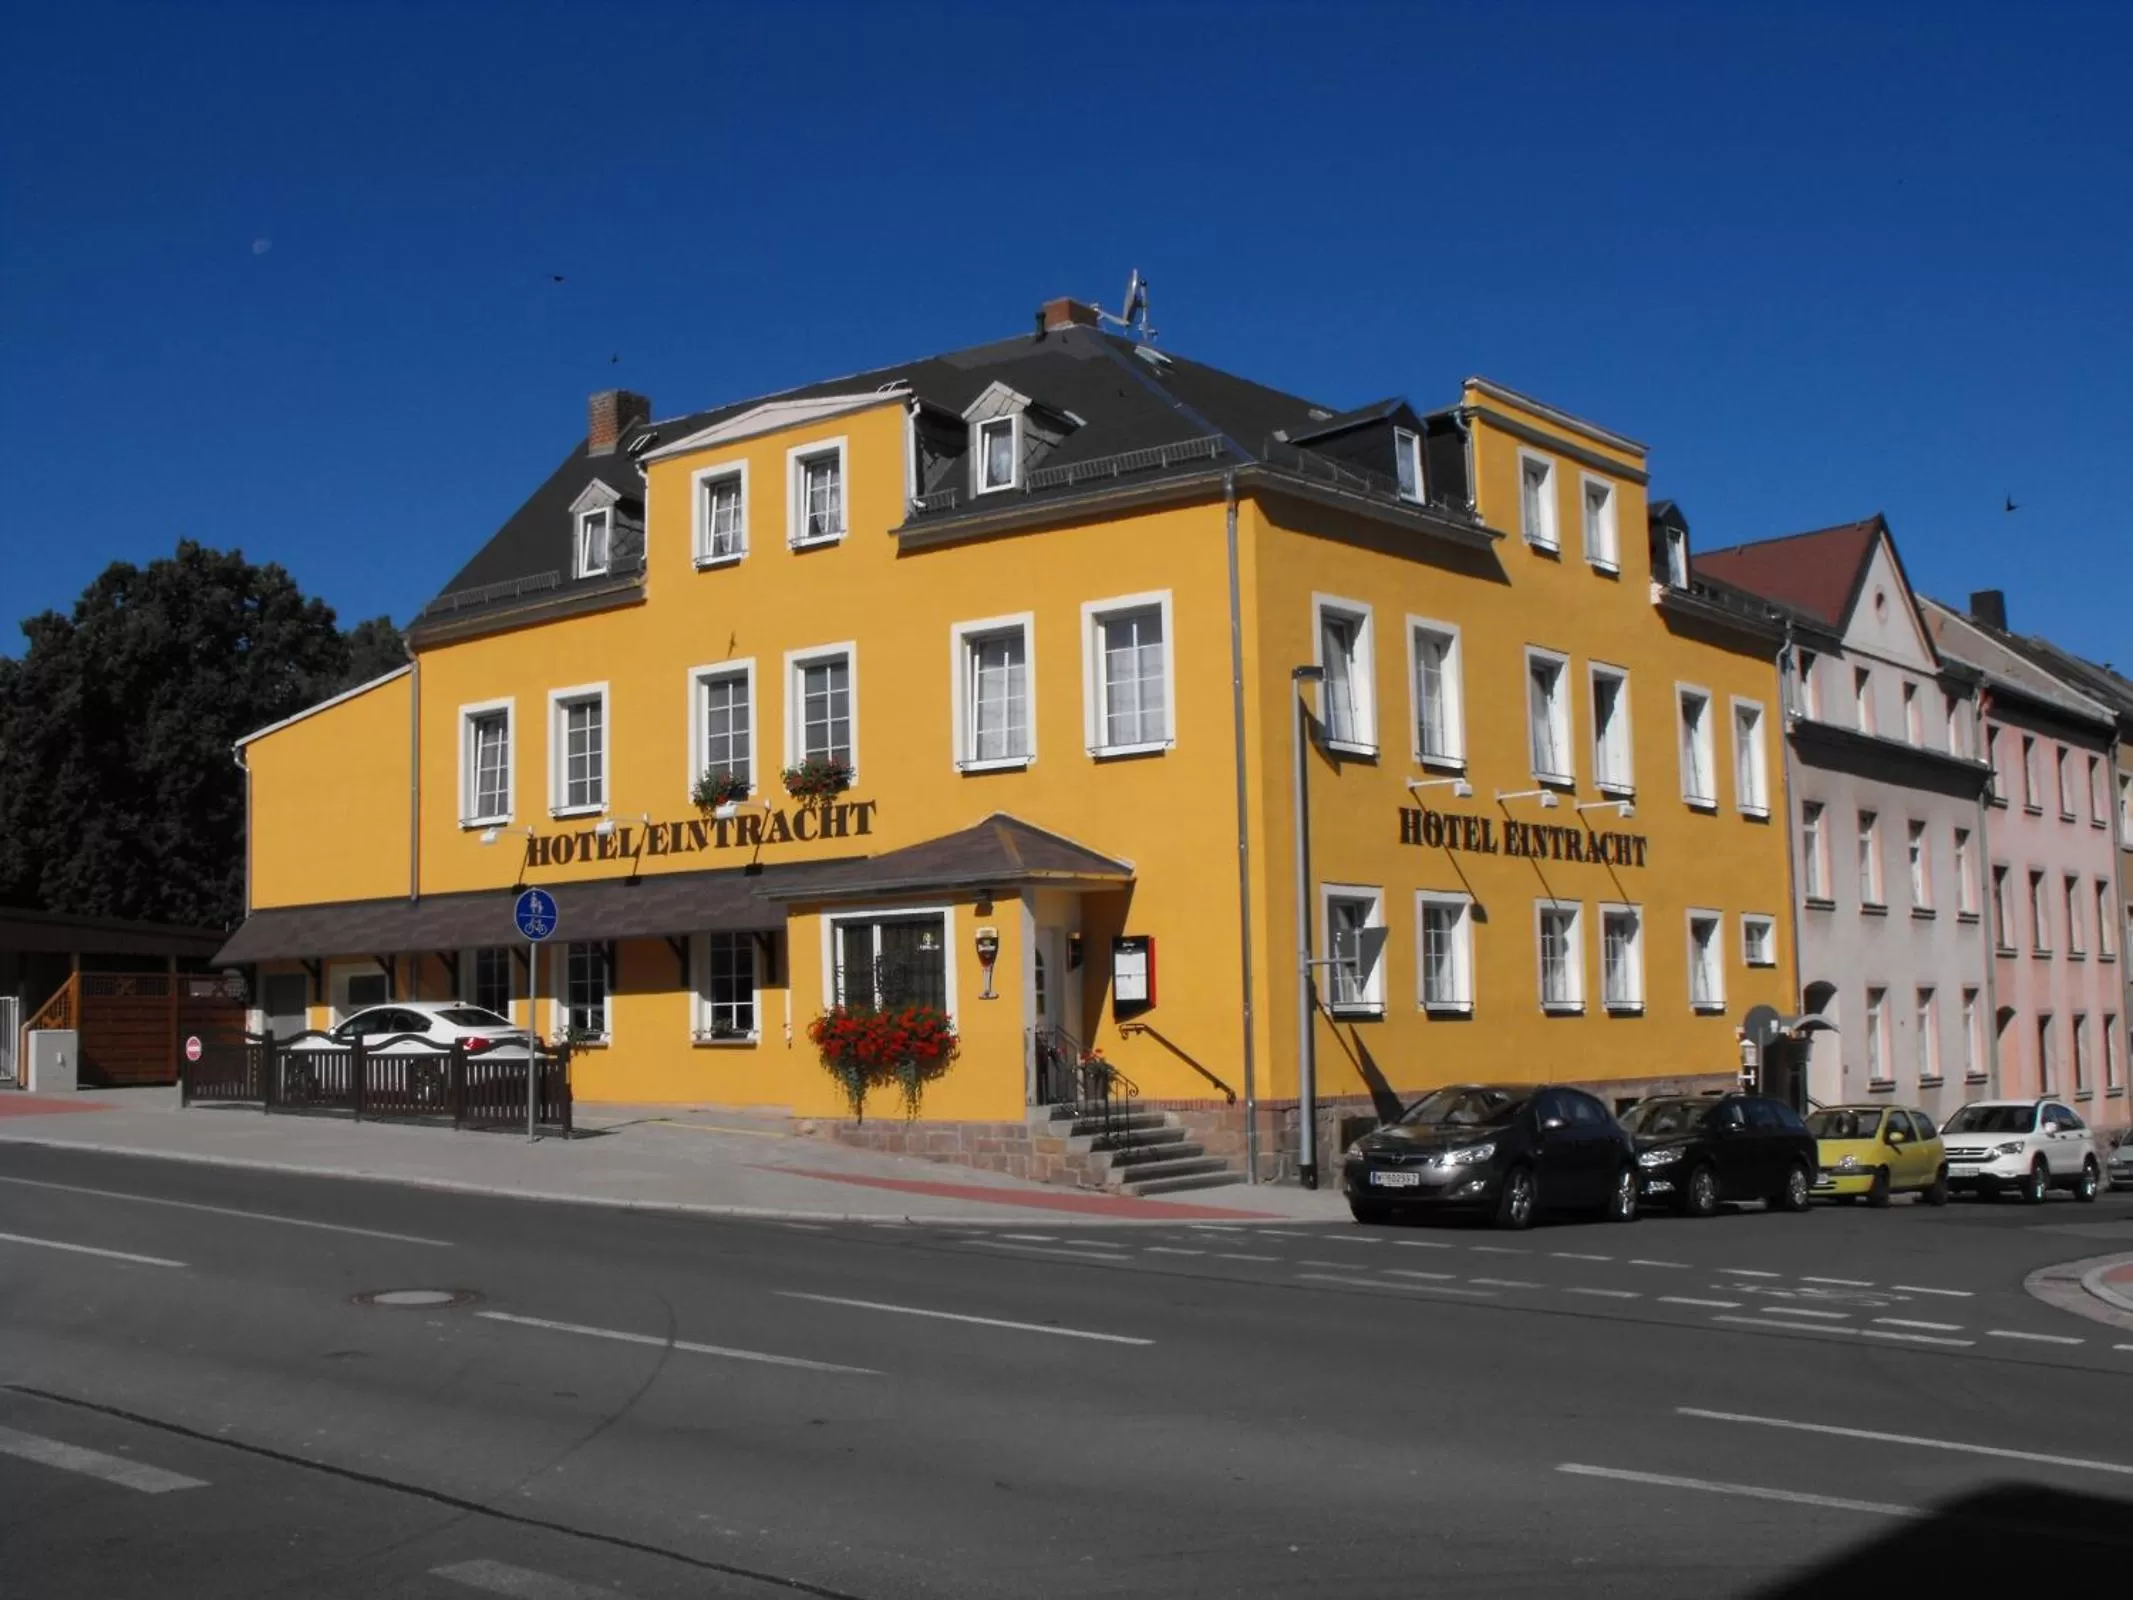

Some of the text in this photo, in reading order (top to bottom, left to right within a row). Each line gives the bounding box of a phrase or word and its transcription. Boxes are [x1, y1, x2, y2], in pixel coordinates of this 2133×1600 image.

[527, 800, 877, 867] HOTEL EINTRACHT
[1398, 807, 1647, 867] HOTEL EINTRACHT
